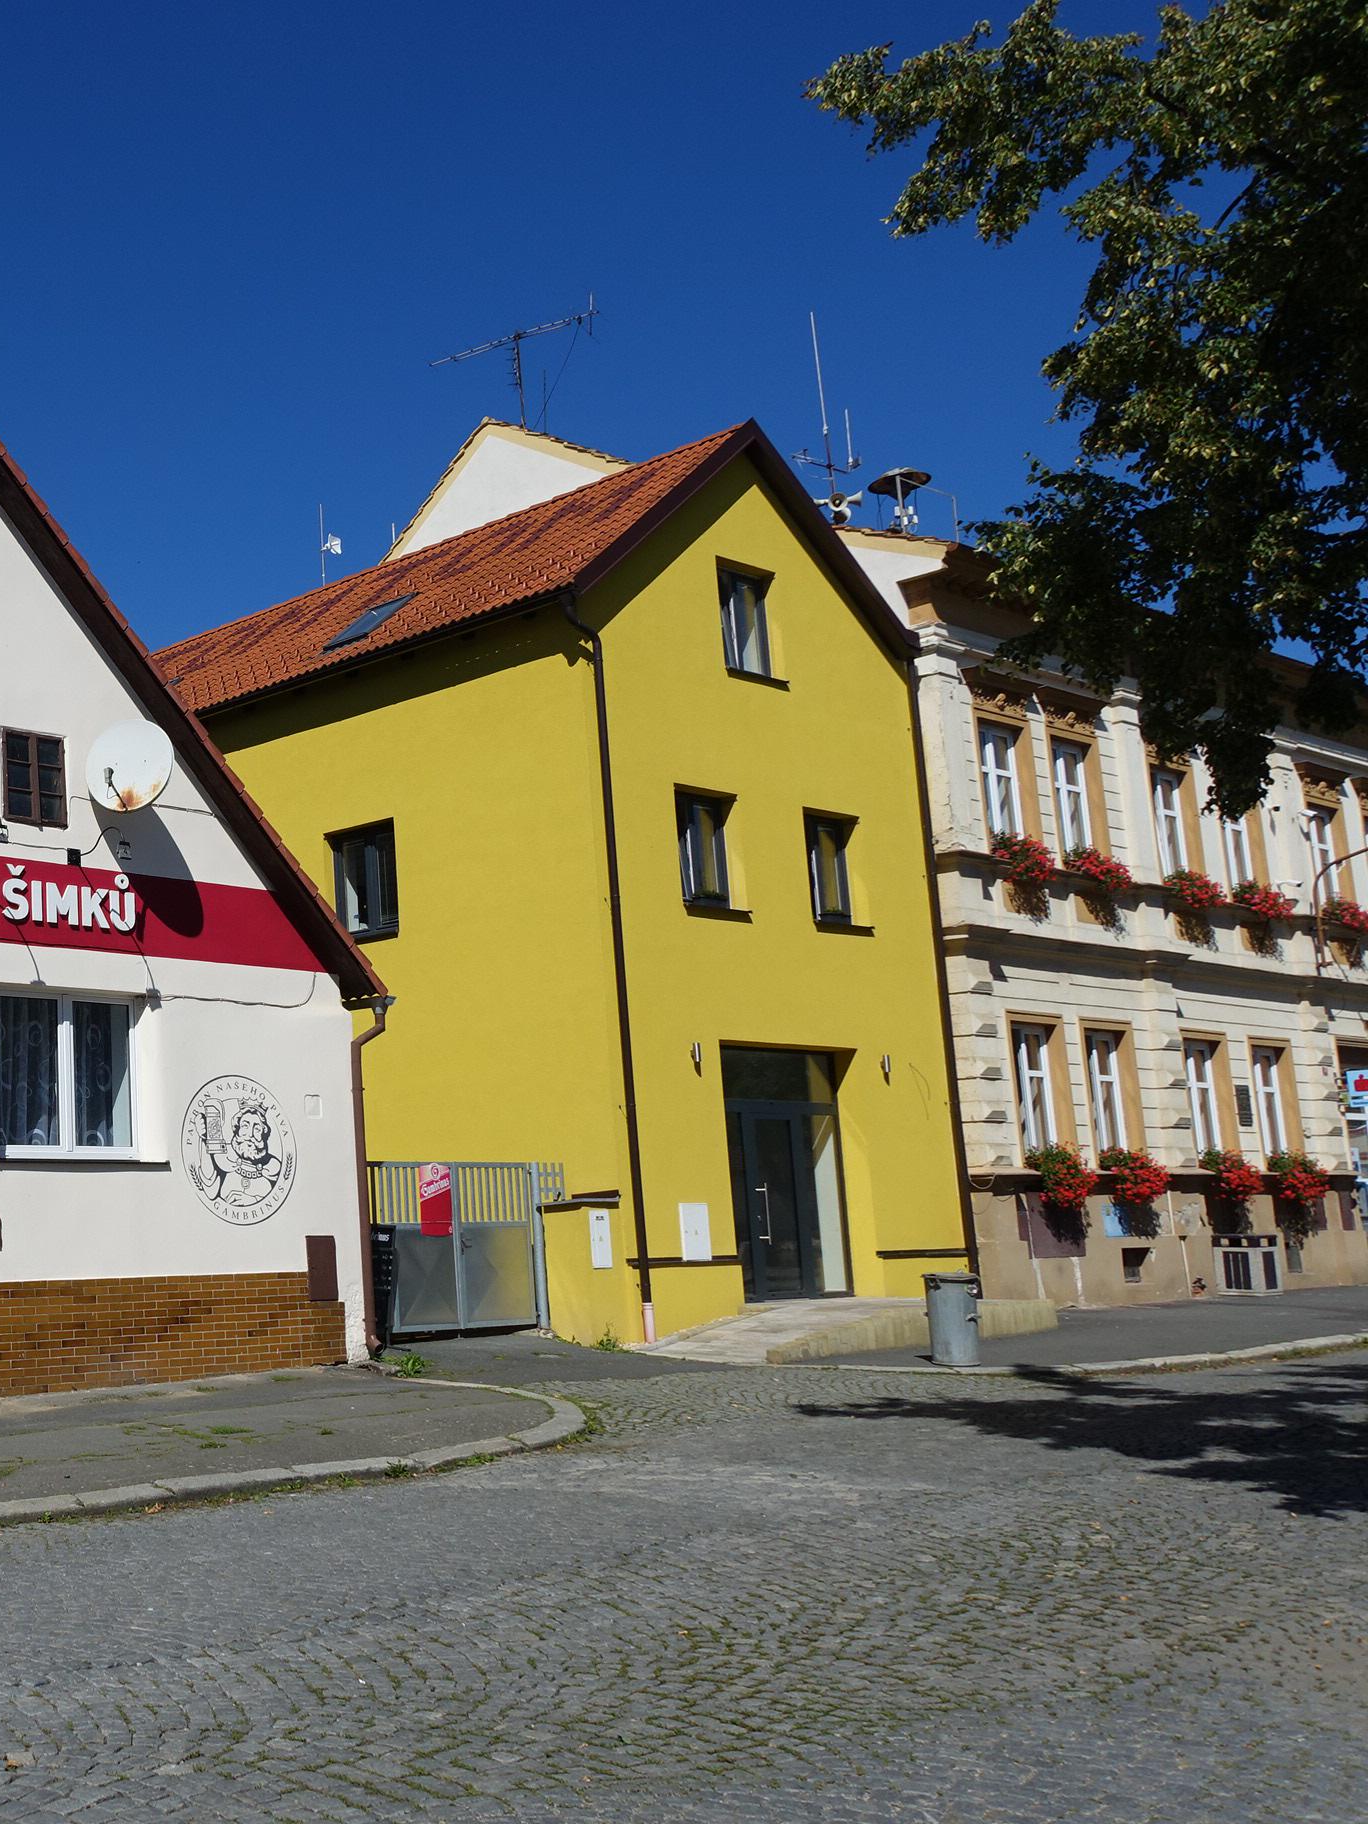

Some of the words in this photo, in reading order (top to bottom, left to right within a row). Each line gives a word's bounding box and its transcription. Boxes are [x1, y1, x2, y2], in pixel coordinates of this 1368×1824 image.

[2, 864, 136, 932] ŠIMKŮ
[186, 1092, 211, 1146] PATRON
[270, 1104, 288, 1137] PIVA
[213, 1185, 285, 1220] GAMBRINUS
